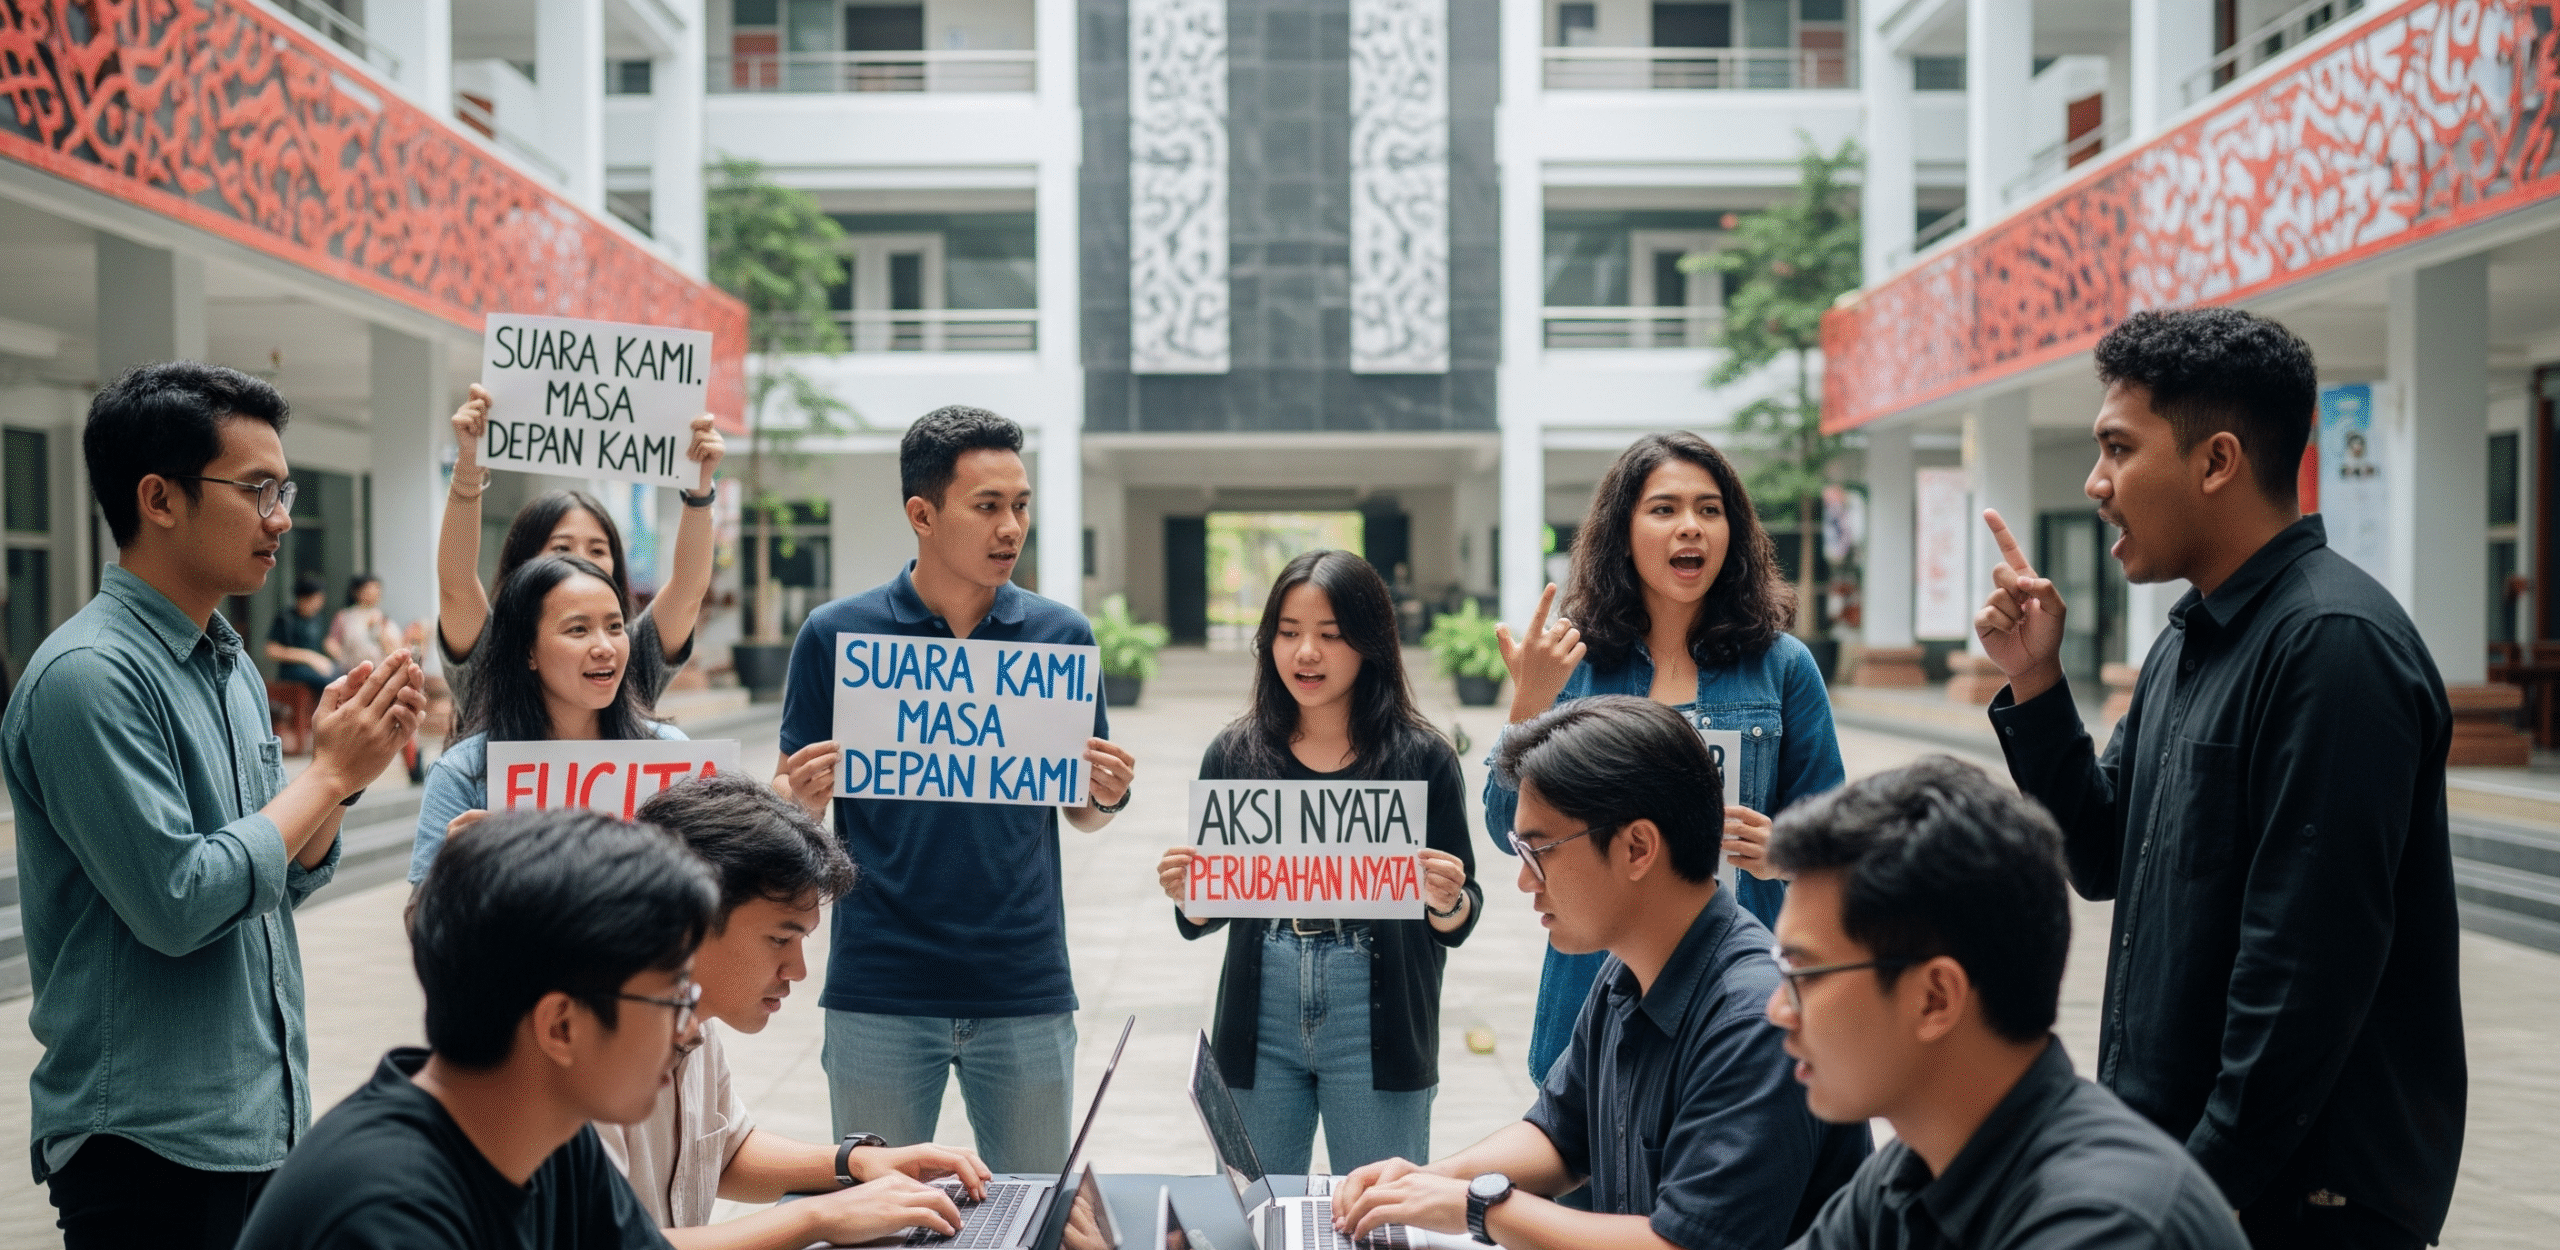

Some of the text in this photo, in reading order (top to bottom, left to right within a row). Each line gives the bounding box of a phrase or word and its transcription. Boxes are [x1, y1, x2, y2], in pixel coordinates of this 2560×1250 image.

[492, 326, 702, 385] SUARA KAMI.
[546, 380, 635, 423] MASA
[488, 419, 584, 466] DEPAN
[842, 640, 1093, 702] SUARA KAMI.
[897, 700, 1005, 747] MASA
[845, 749, 976, 797] DEPAN
[1196, 788, 1281, 845] AKSI
[1189, 855, 1420, 901] PERUBAHAN NYATA
